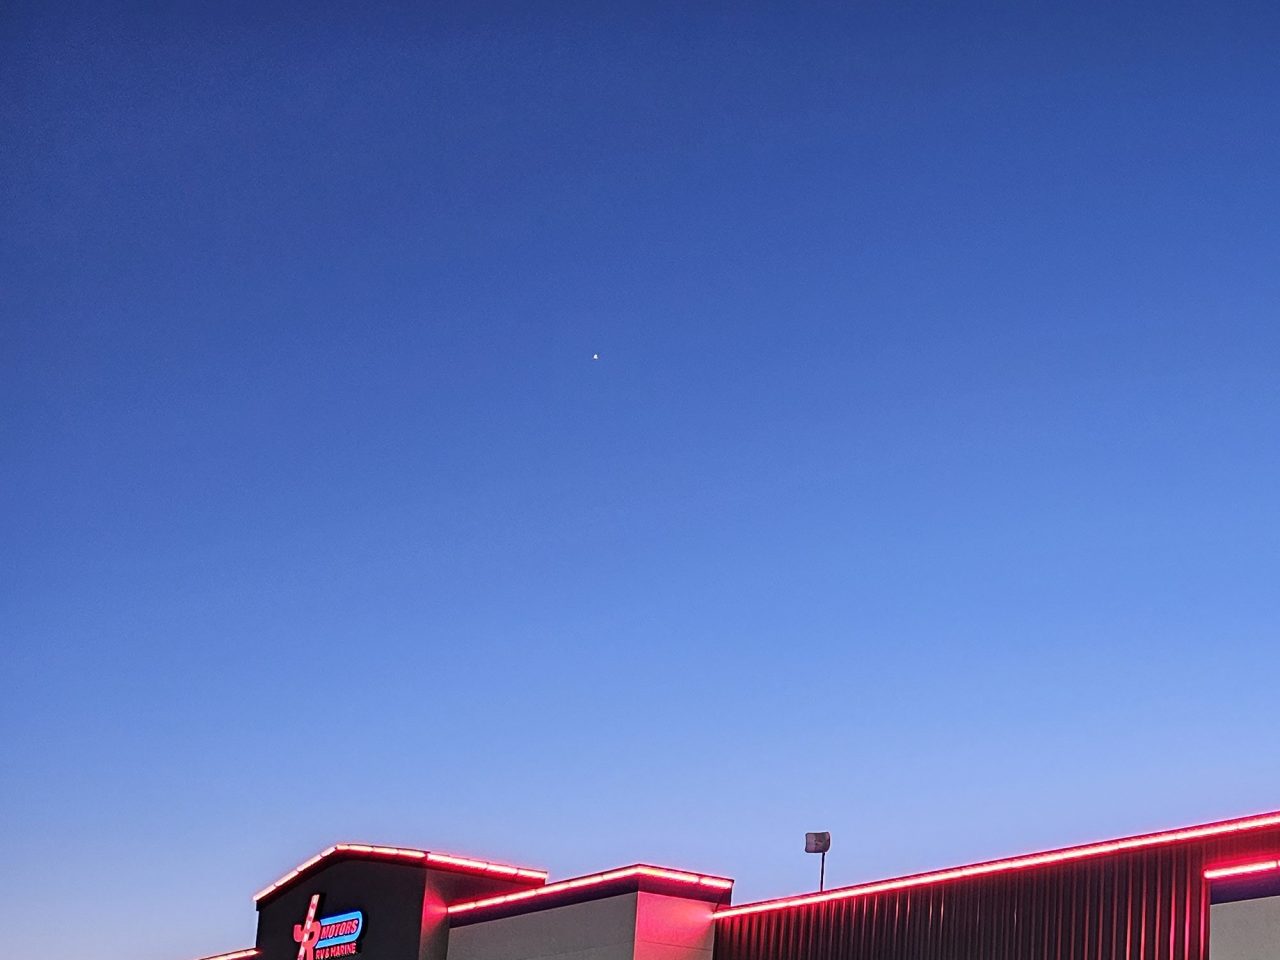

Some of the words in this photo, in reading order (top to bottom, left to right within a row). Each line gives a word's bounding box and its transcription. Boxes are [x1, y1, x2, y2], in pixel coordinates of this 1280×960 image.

[321, 920, 358, 939] MOTORS
[316, 949, 325, 959] RV
[330, 943, 356, 957] MARINE
